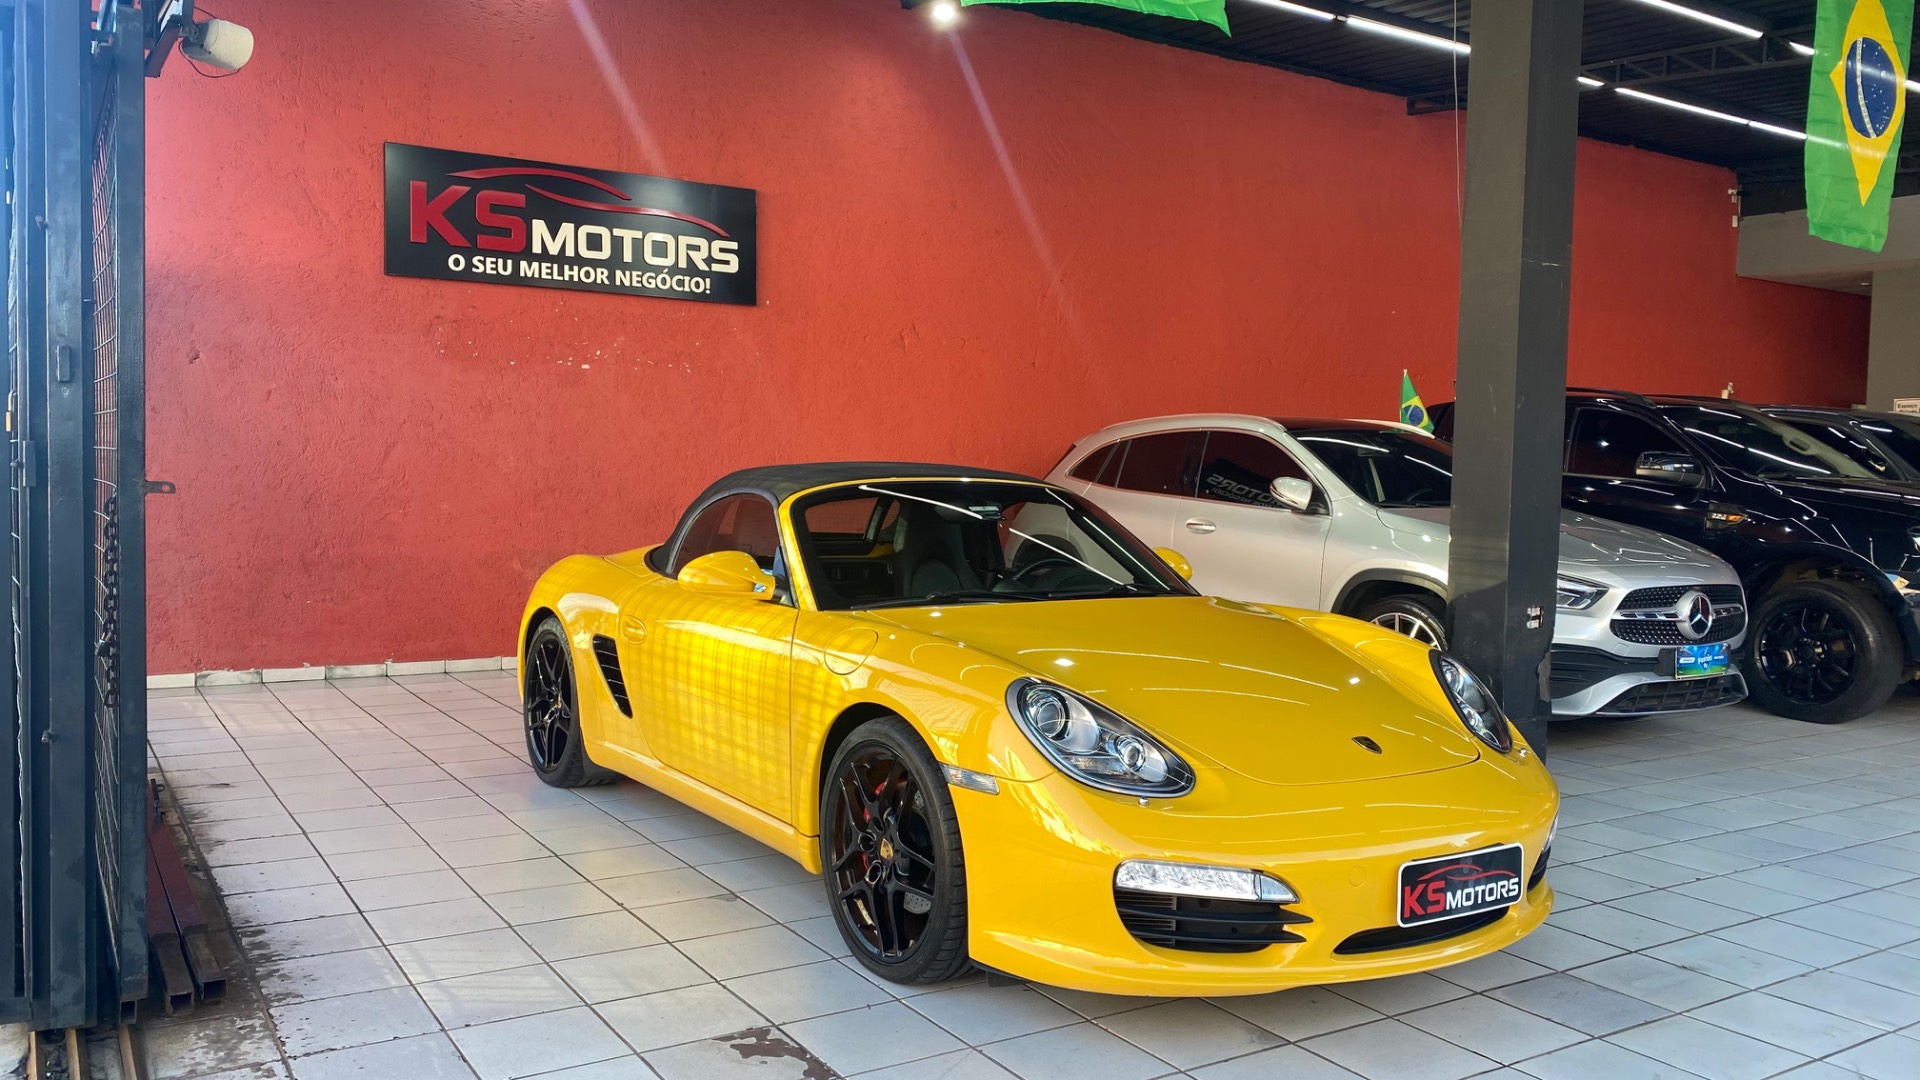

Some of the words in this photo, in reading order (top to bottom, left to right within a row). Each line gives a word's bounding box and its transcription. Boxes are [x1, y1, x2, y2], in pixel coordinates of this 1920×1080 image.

[531, 219, 739, 274] MOTORS
[448, 253, 465, 272] O
[471, 255, 513, 276] SEU
[519, 260, 610, 285] MELHOR
[615, 268, 711, 294] NEGÓCIO!
[1446, 877, 1519, 910] MOTORS
